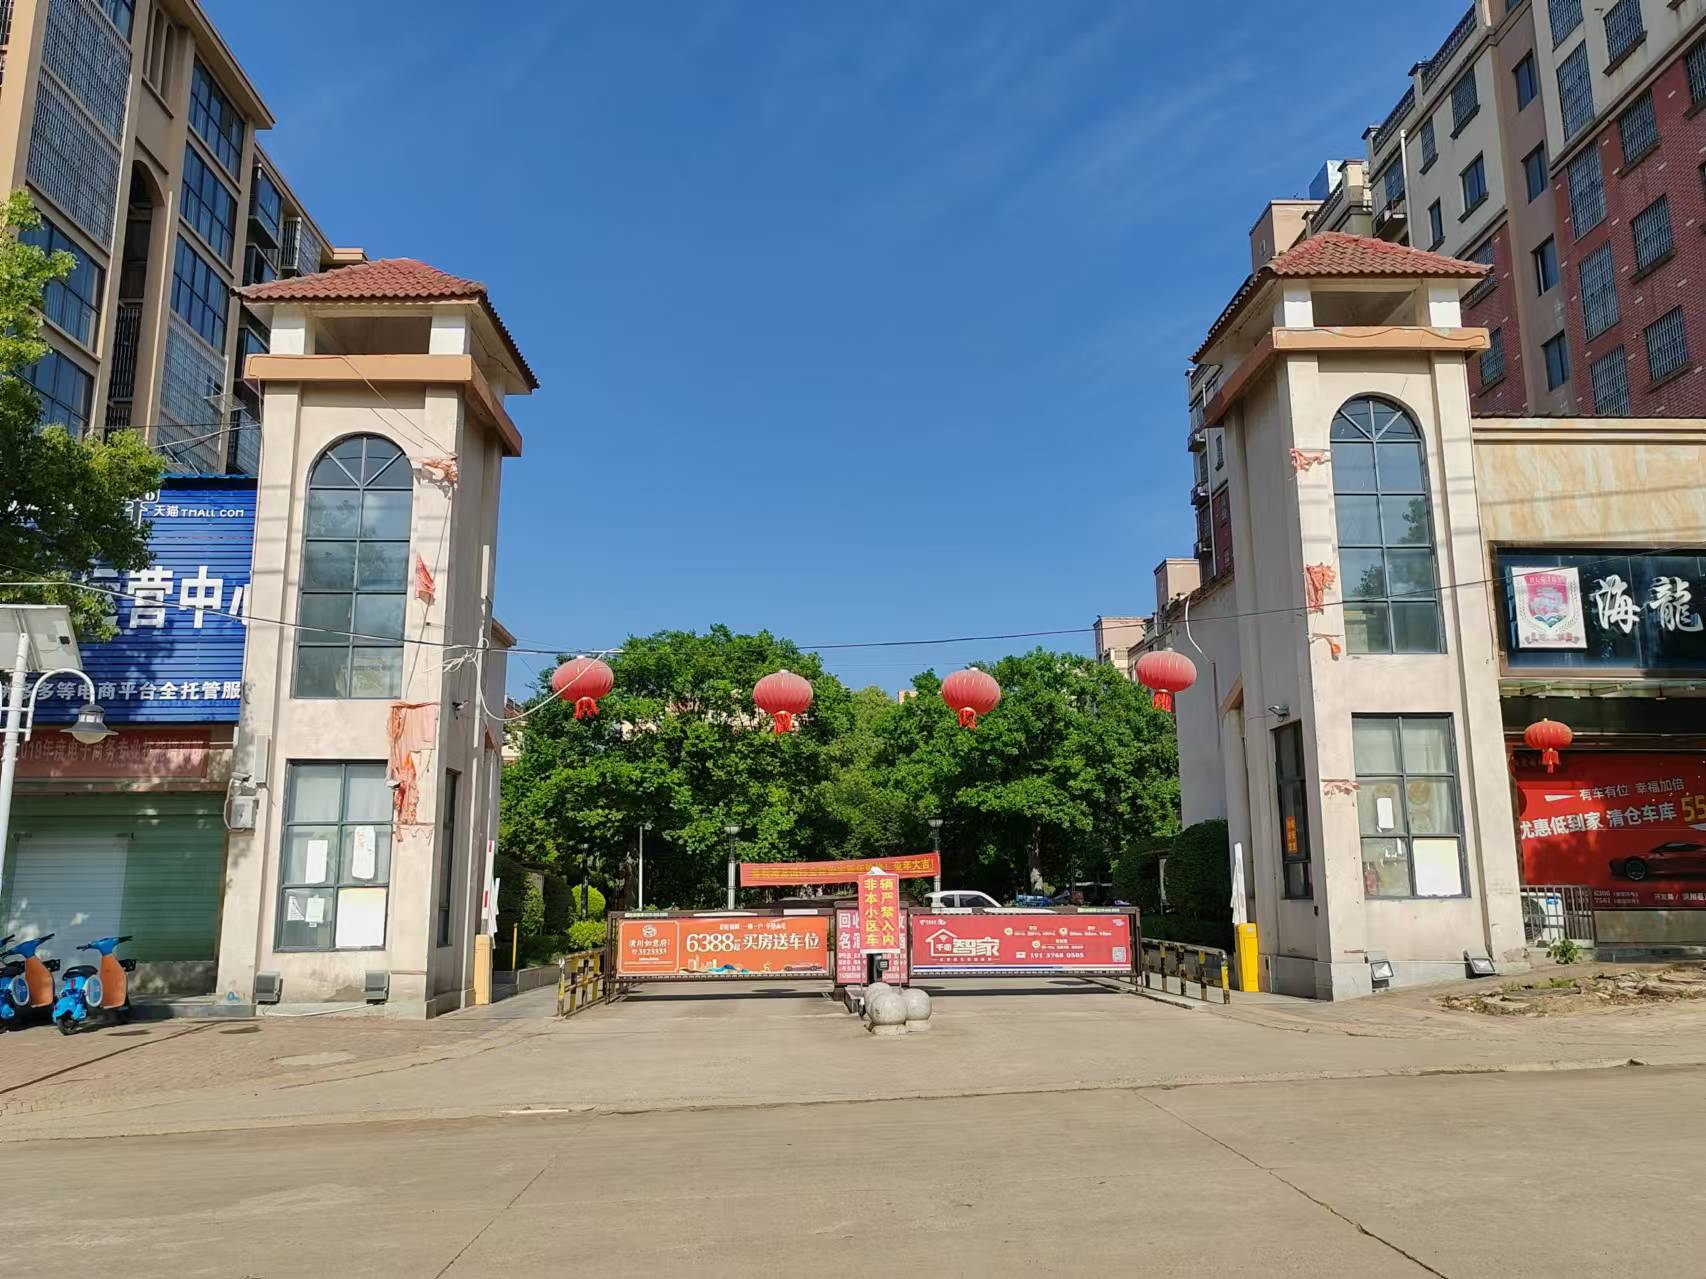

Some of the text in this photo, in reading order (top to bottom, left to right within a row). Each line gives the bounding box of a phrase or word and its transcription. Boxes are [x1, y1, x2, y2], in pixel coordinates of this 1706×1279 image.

[153, 504, 179, 517] 天猫
[1580, 778, 1685, 801] 有车有位 幸福加倍
[1520, 811, 1604, 839] 优惠低到家
[1606, 802, 1678, 828] 清仓车库
[864, 878, 880, 946] 非本小区车
[880, 878, 896, 946] 辆严禁入内
[743, 932, 820, 951] 买房送车位
